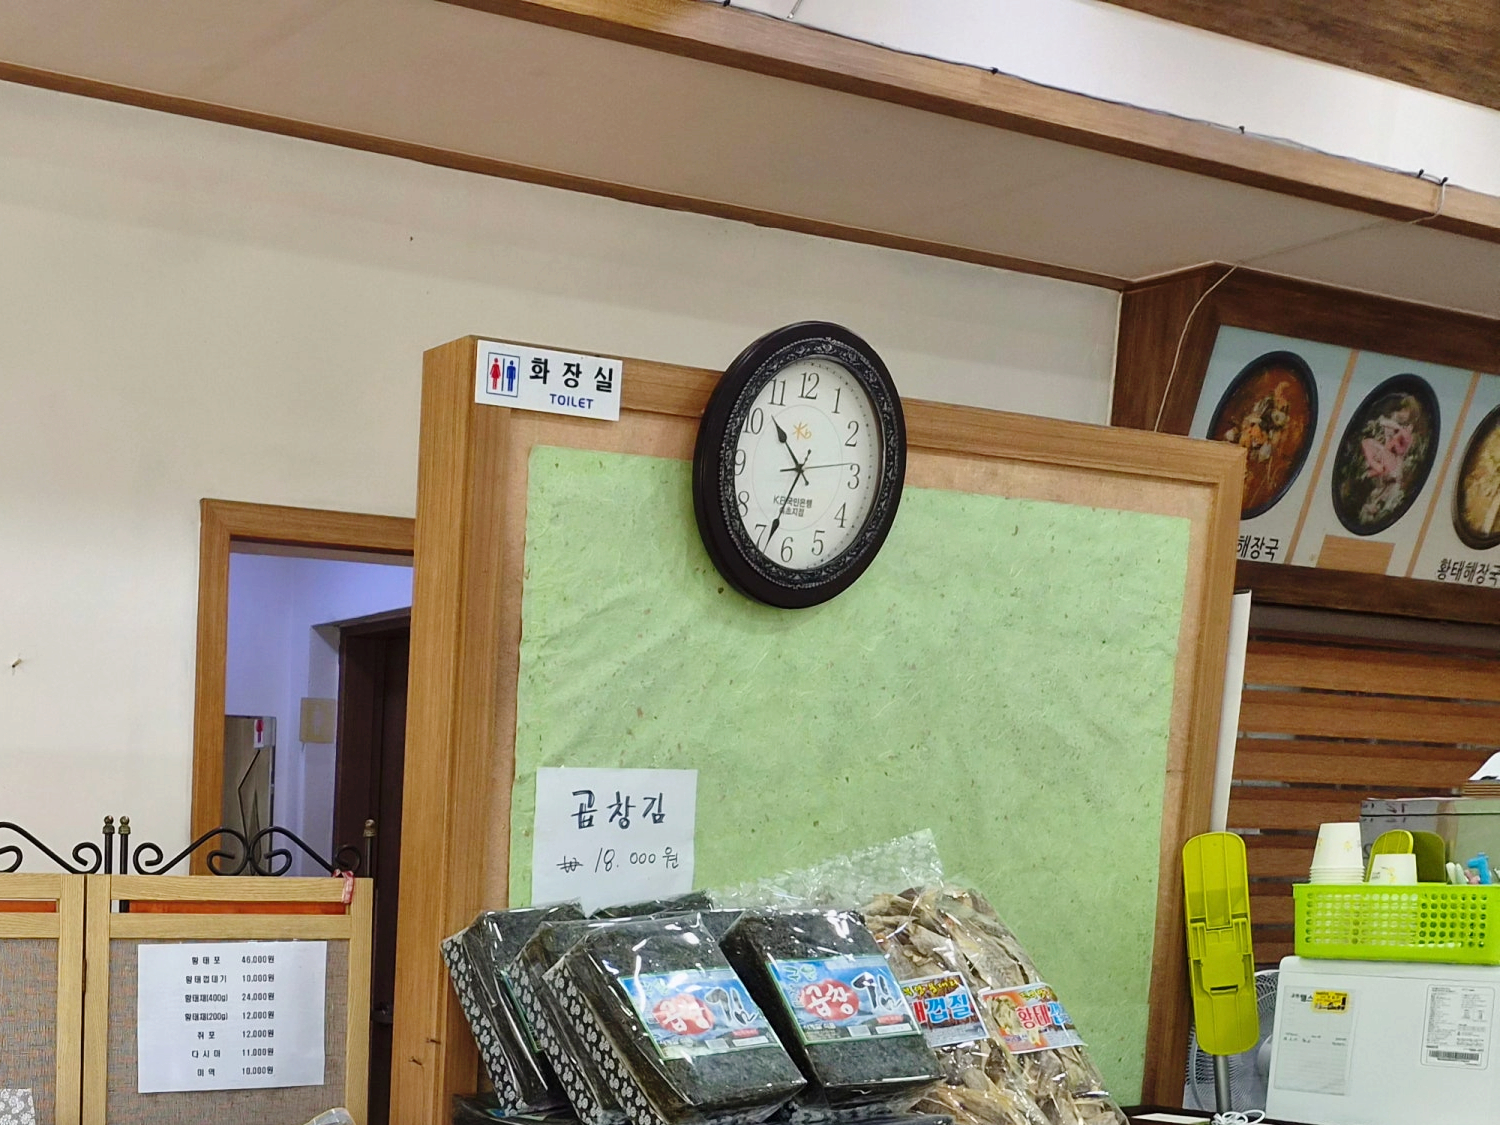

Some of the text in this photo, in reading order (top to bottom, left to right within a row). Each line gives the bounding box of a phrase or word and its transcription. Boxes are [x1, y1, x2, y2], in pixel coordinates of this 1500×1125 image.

[768, 378, 787, 406] 11
[799, 372, 820, 400] 12
[549, 393, 594, 410] TOILET
[831, 387, 841, 414] 1
[743, 407, 764, 435] 10
[845, 420, 860, 447] 2
[847, 463, 860, 490] 3
[834, 502, 847, 528] 4
[780, 536, 794, 563] 6
[811, 530, 826, 556] 5
